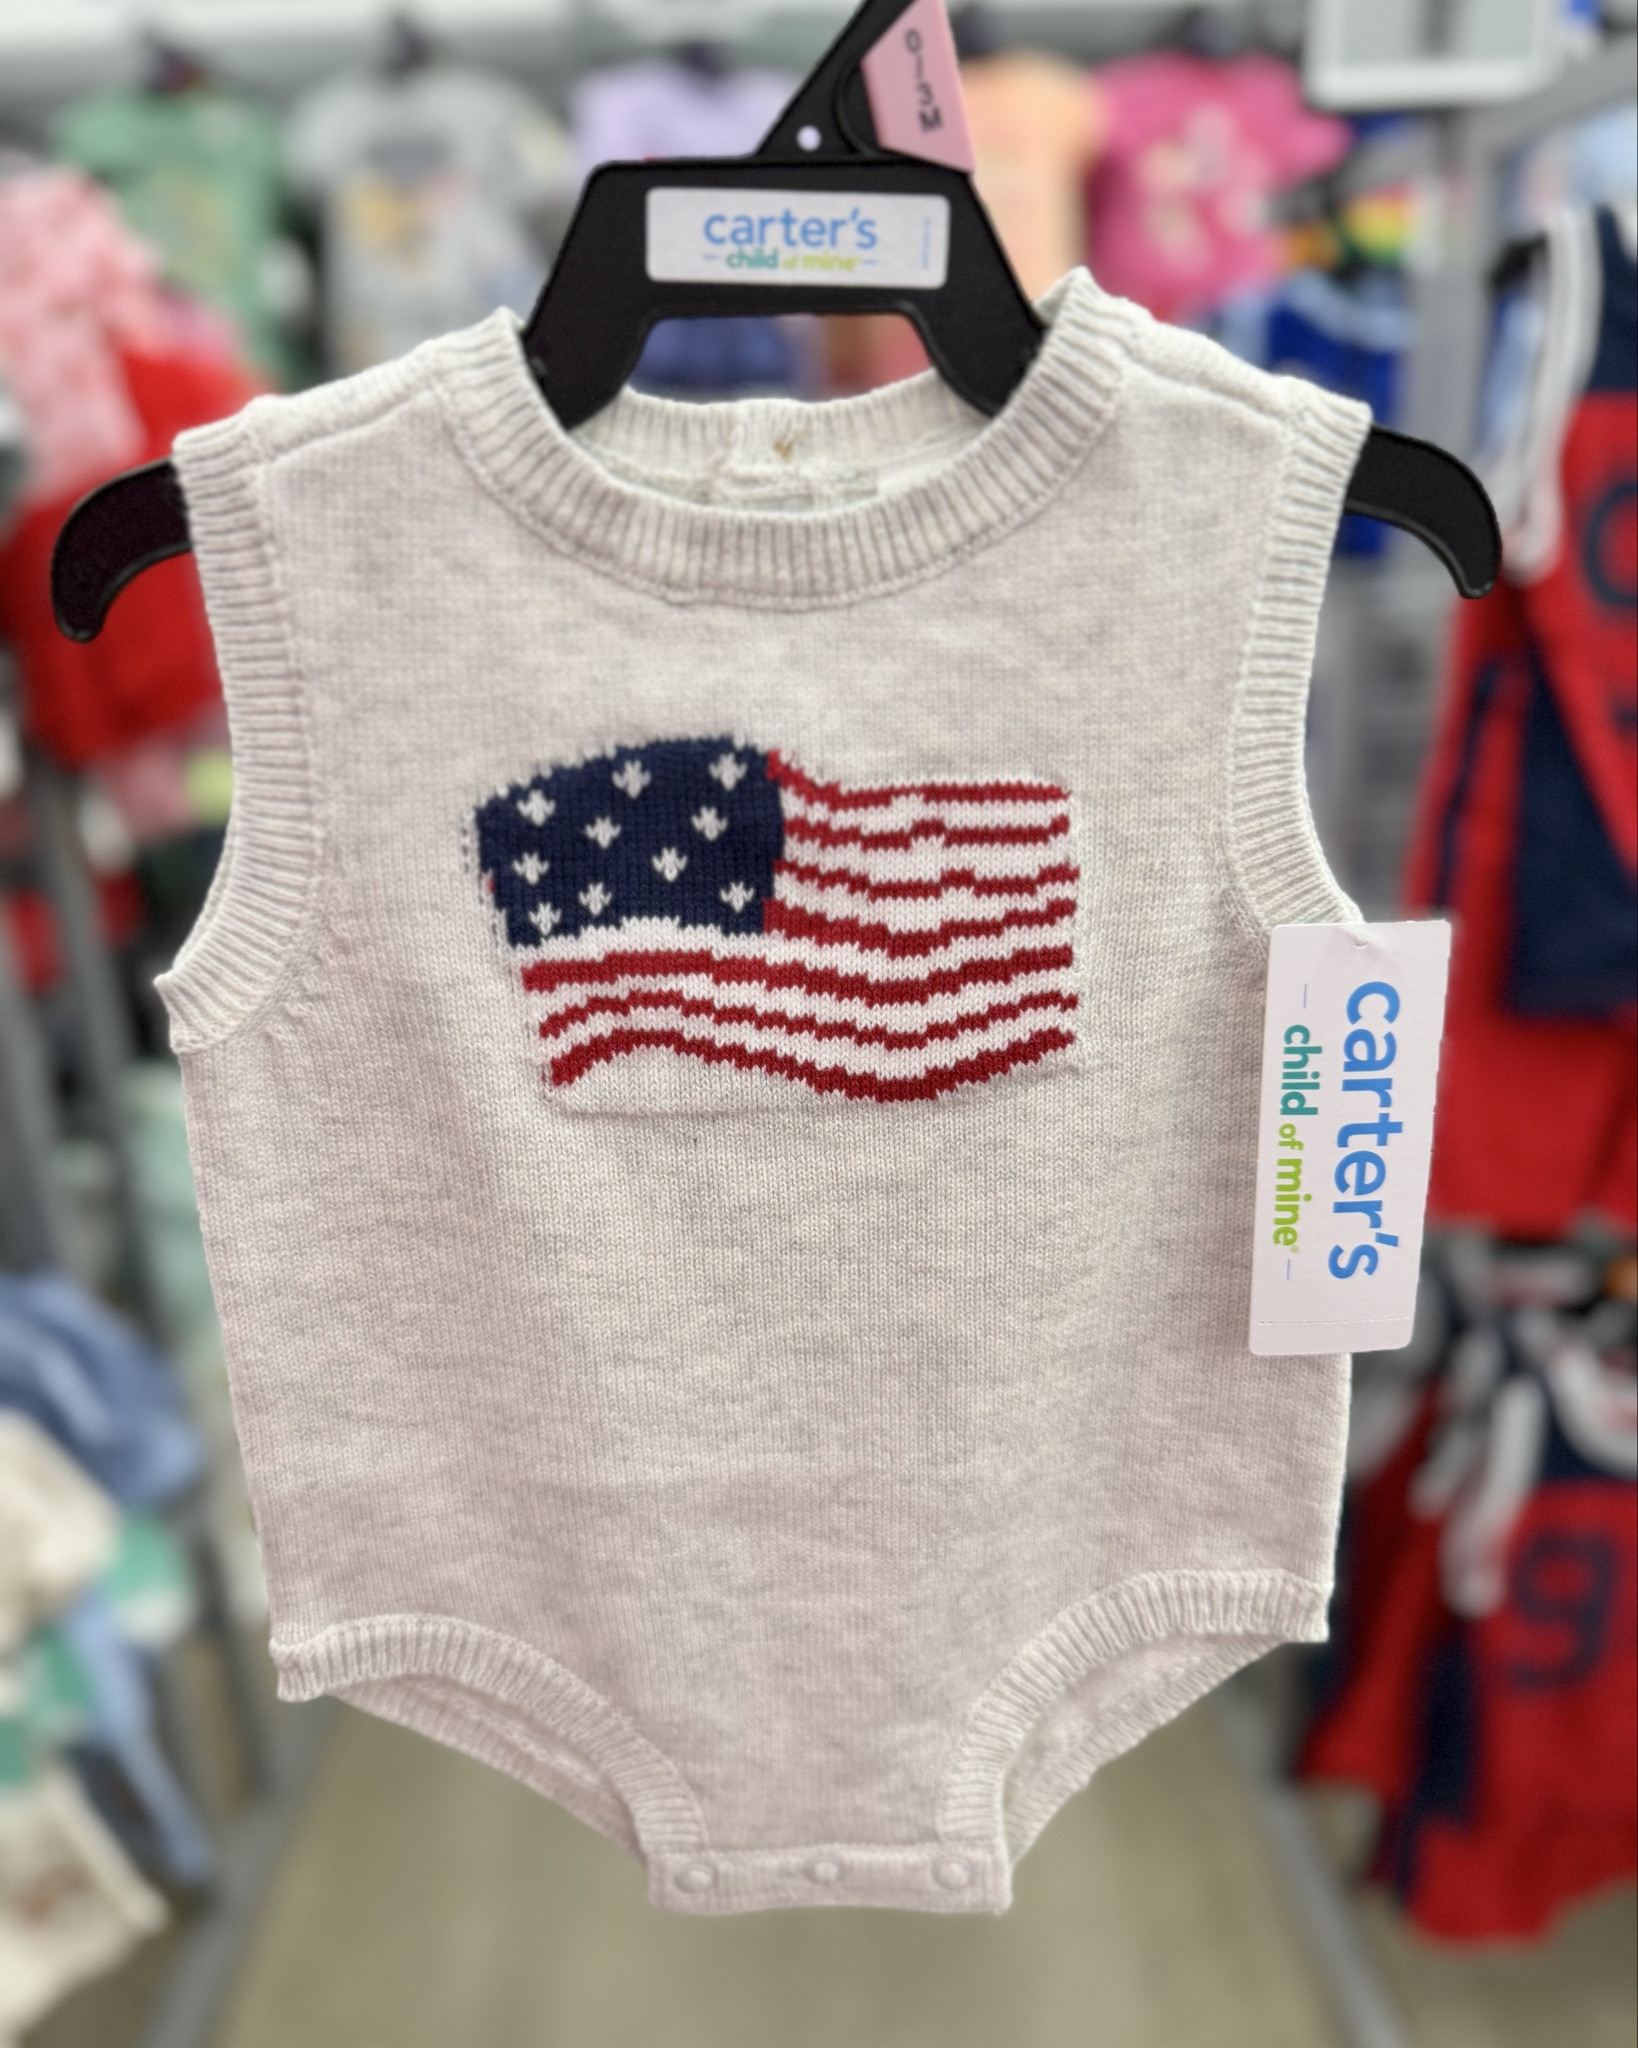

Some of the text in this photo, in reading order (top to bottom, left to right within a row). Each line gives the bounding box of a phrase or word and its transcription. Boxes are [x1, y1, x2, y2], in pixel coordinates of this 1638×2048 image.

[703, 206, 877, 249] carter's
[726, 249, 779, 269] child
[782, 253, 799, 270] of
[1280, 1024, 1322, 1115] child
[1278, 1123, 1304, 1149] of
[1328, 981, 1403, 1279] carter's
